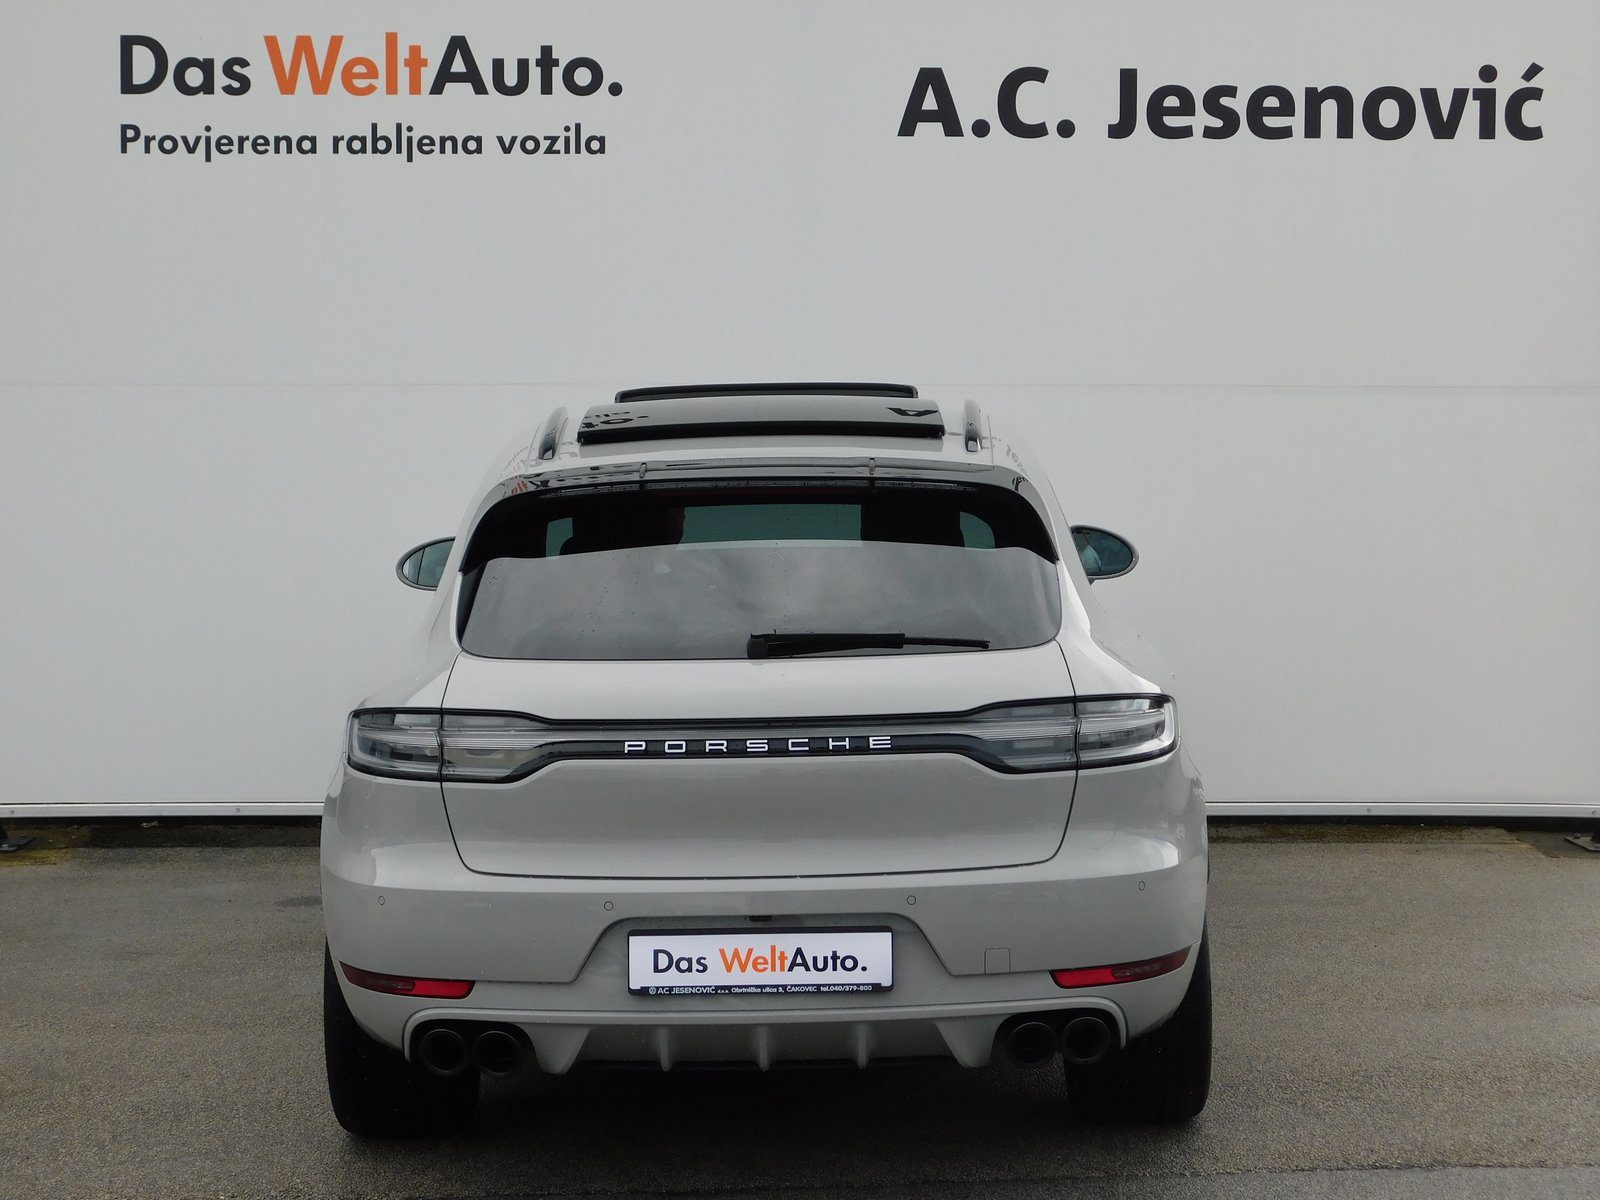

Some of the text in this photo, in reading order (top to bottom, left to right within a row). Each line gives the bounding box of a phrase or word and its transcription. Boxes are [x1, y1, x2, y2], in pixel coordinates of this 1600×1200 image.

[120, 32, 623, 97] Das WeltAuto.
[897, 62, 1544, 141] A.C. Jesenović
[121, 123, 605, 162] Provjerena rabljena vozila
[624, 737, 892, 753] PORSCHE
[653, 945, 868, 973] Das WeltAuto.
[671, 985, 716, 994] JESENOVIĆ
